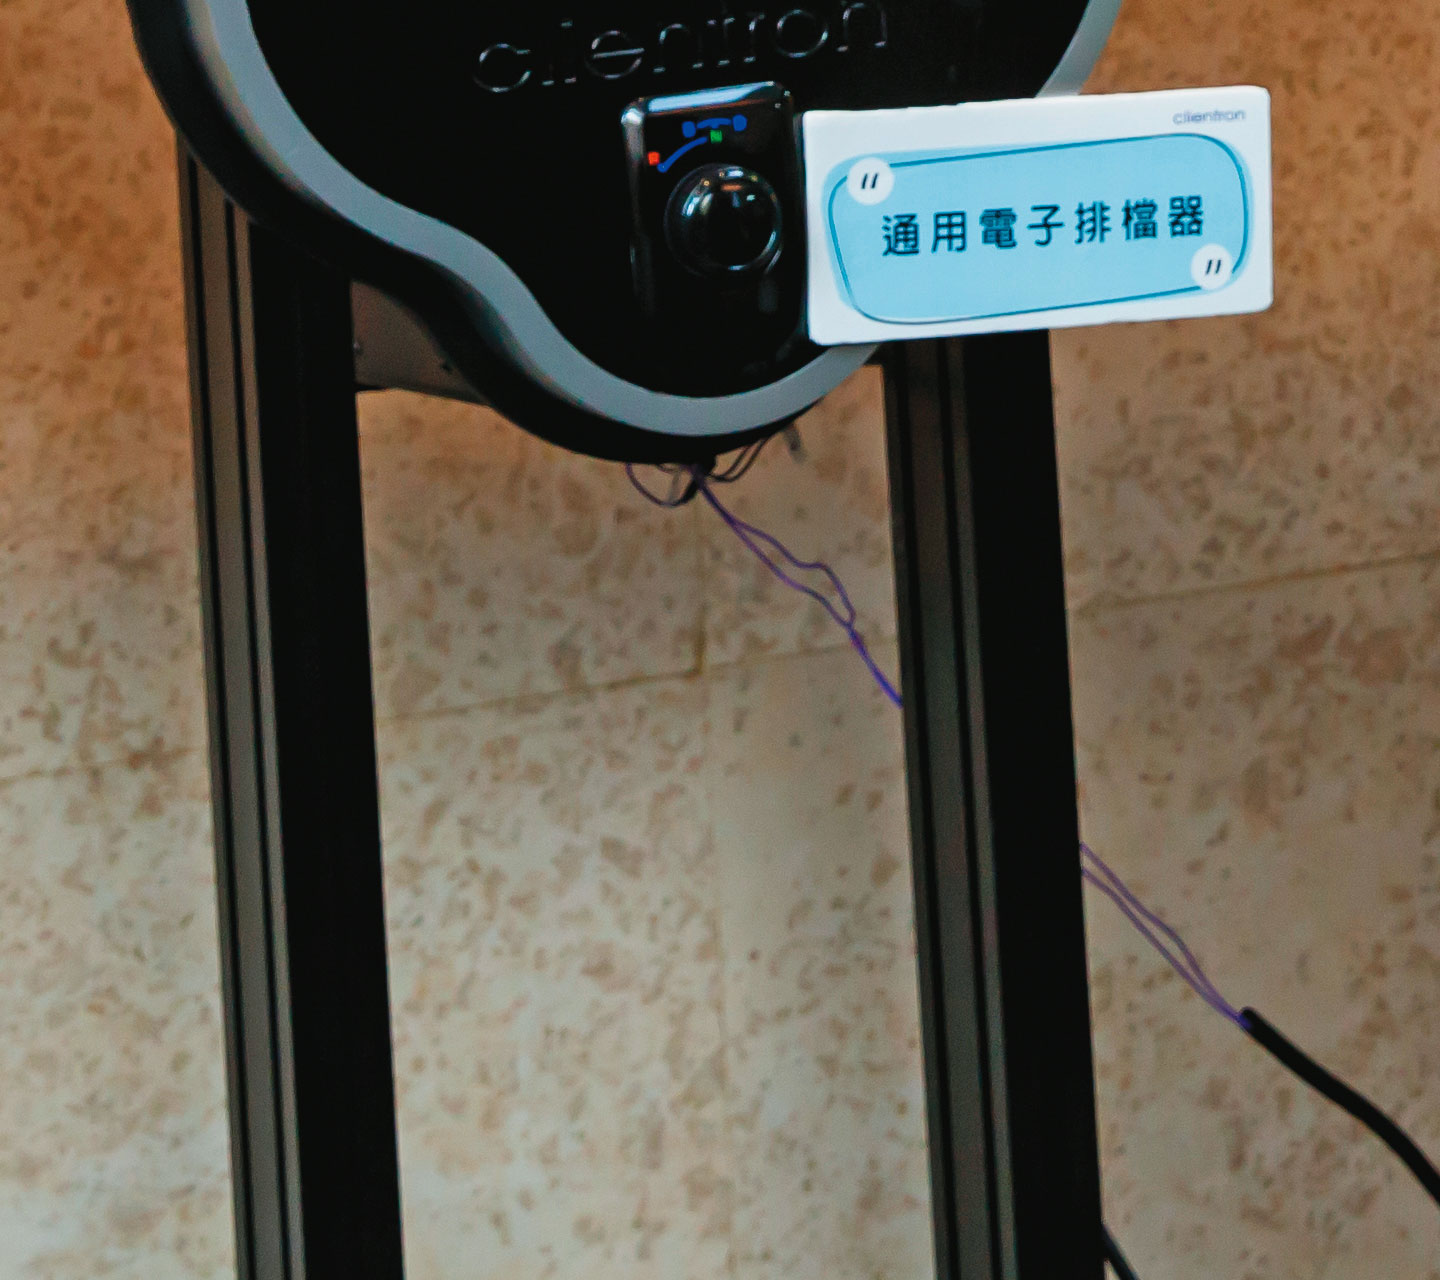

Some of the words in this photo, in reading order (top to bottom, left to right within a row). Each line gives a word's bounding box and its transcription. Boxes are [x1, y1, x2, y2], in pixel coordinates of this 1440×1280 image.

[881, 194, 1205, 258] 通用電子排檔器
